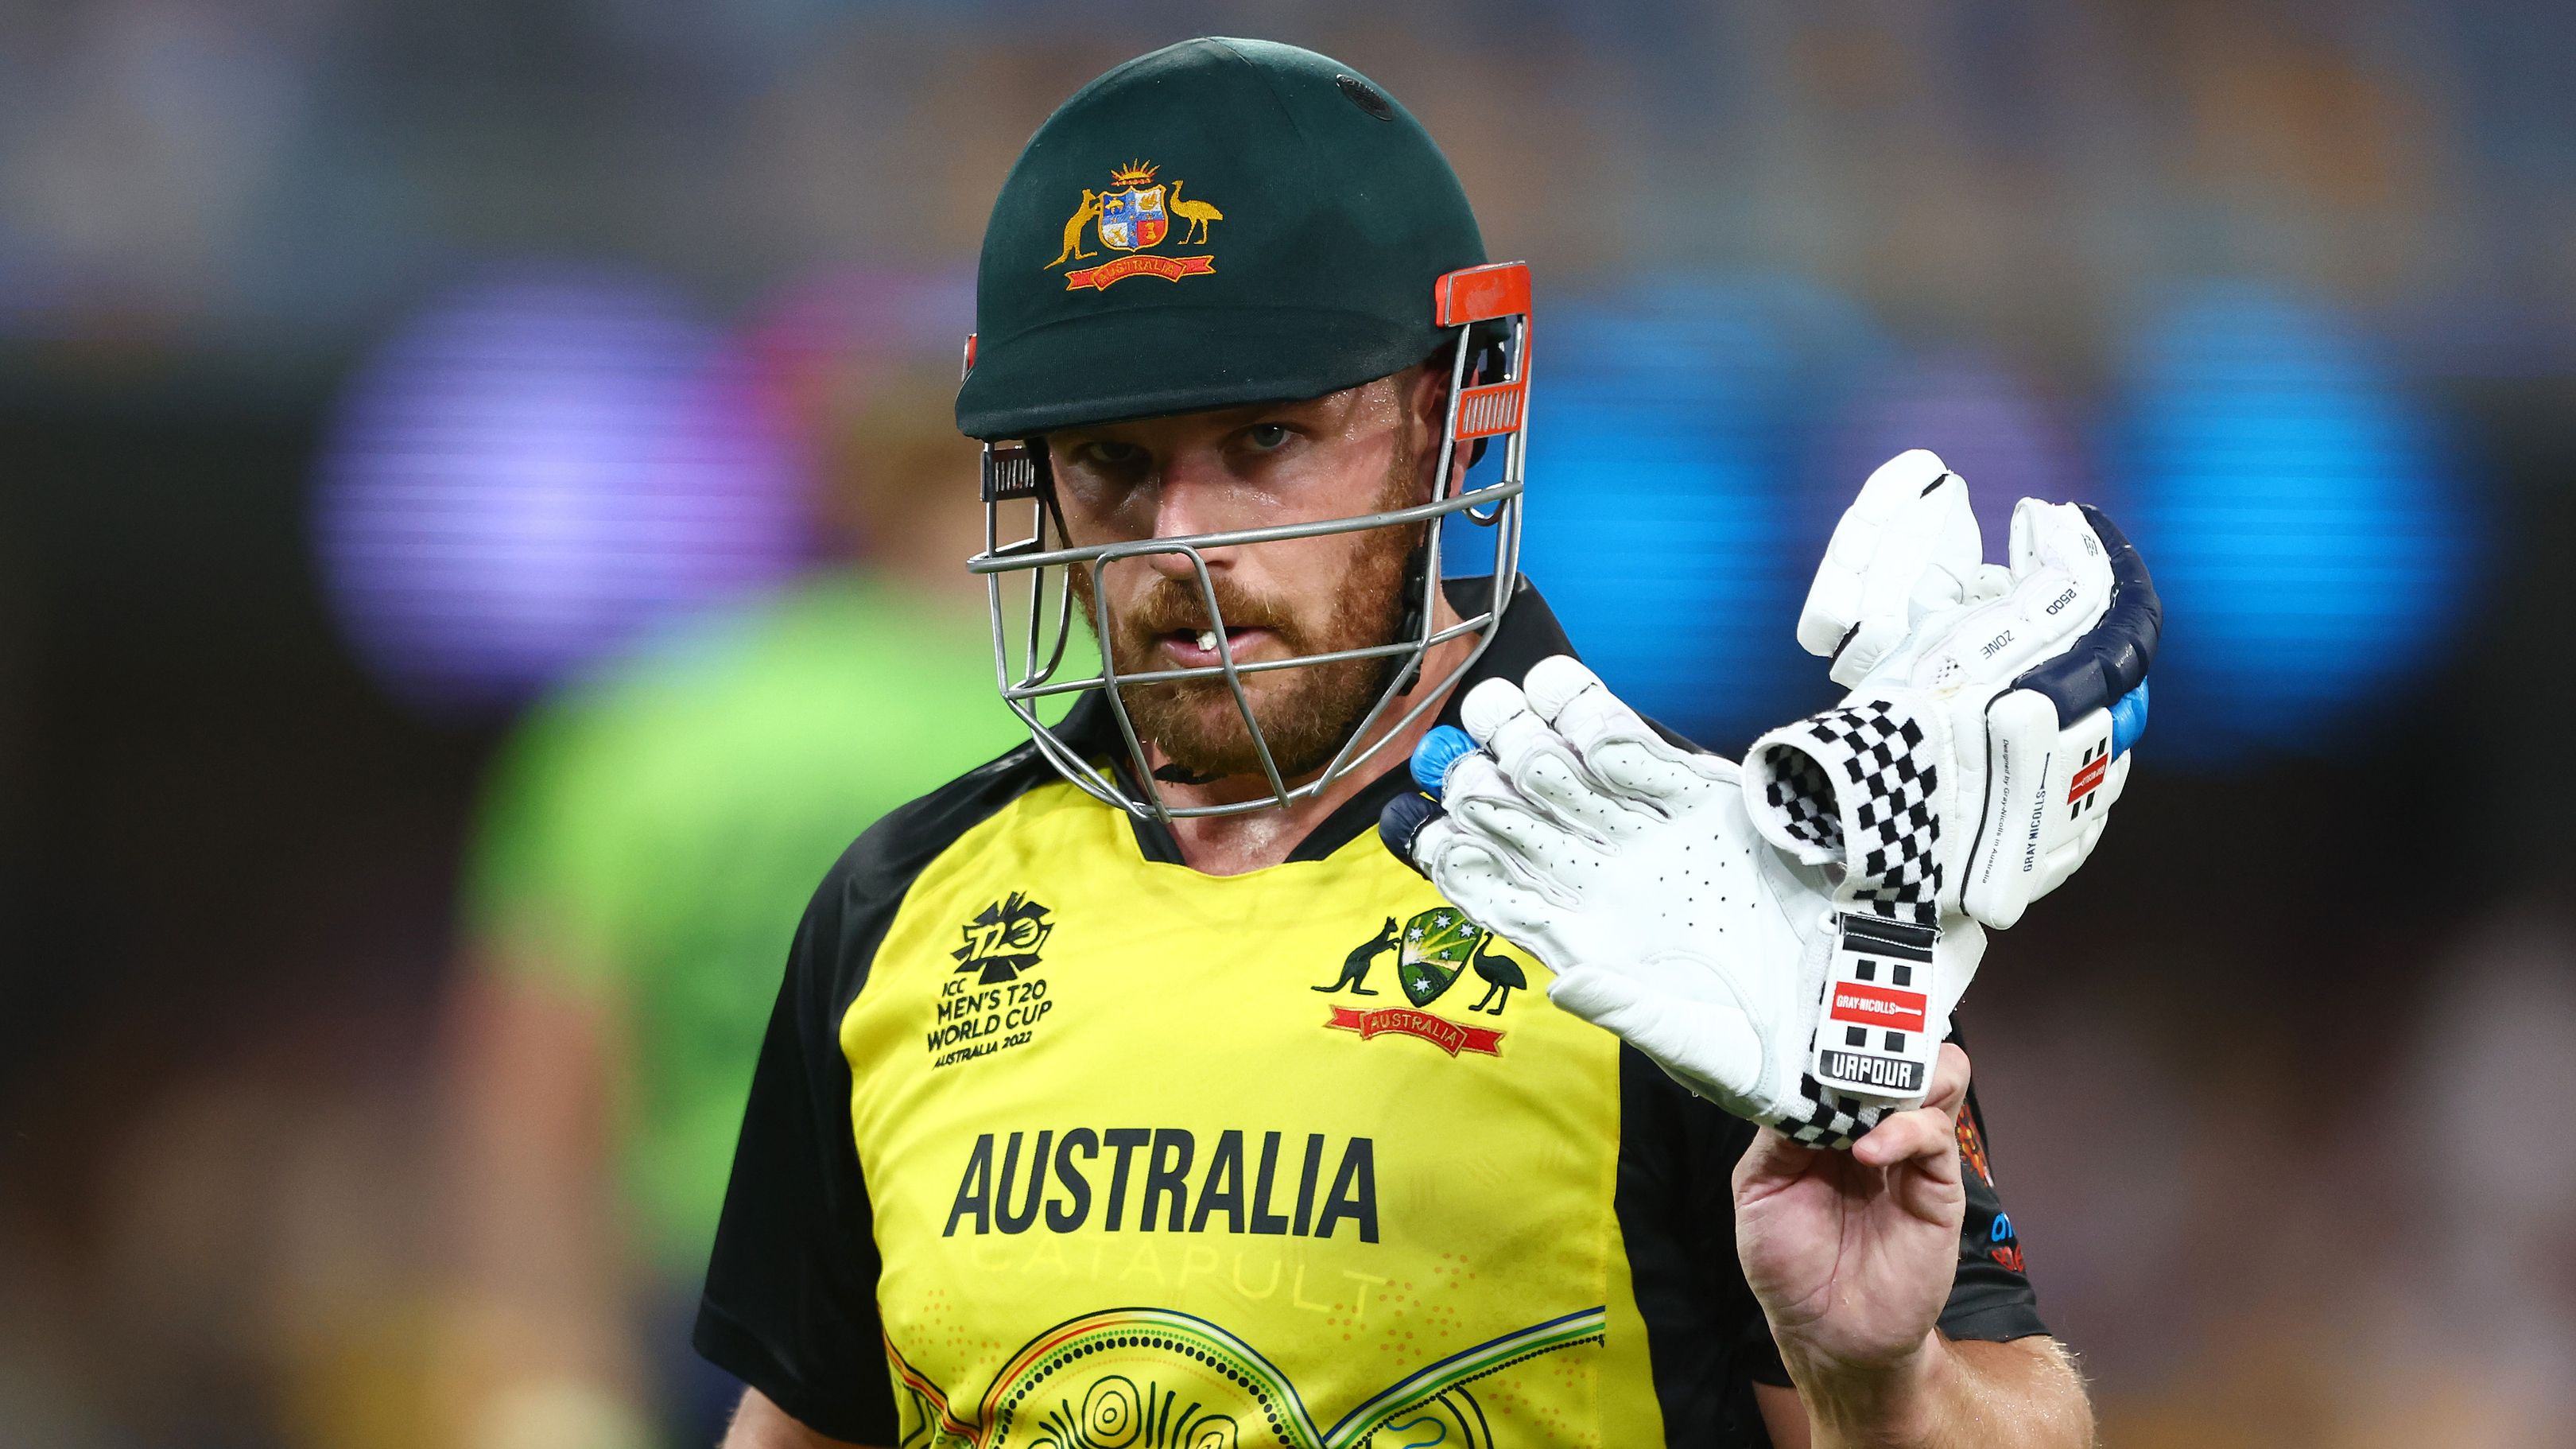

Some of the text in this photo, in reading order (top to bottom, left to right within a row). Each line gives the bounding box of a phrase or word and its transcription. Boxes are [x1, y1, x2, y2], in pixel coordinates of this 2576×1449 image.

[1098, 259, 1174, 283] AUSTRALIA
[1979, 629, 2015, 660] ZONE
[1982, 738, 2011, 884] Designed by Gray-Nicolls in Australia
[937, 979, 1047, 1025] MEN'S T20
[942, 977, 967, 998] ICC
[927, 1000, 1053, 1053] WORLD CUP
[1370, 1012, 1457, 1047] AUSTRALIA
[931, 1030, 1033, 1071] AUSTRALIA 2022
[1831, 1052, 1913, 1089] VAPOUR
[941, 1127, 1379, 1244] AUSTRALIA
[969, 1233, 1390, 1323] CATAPULT
